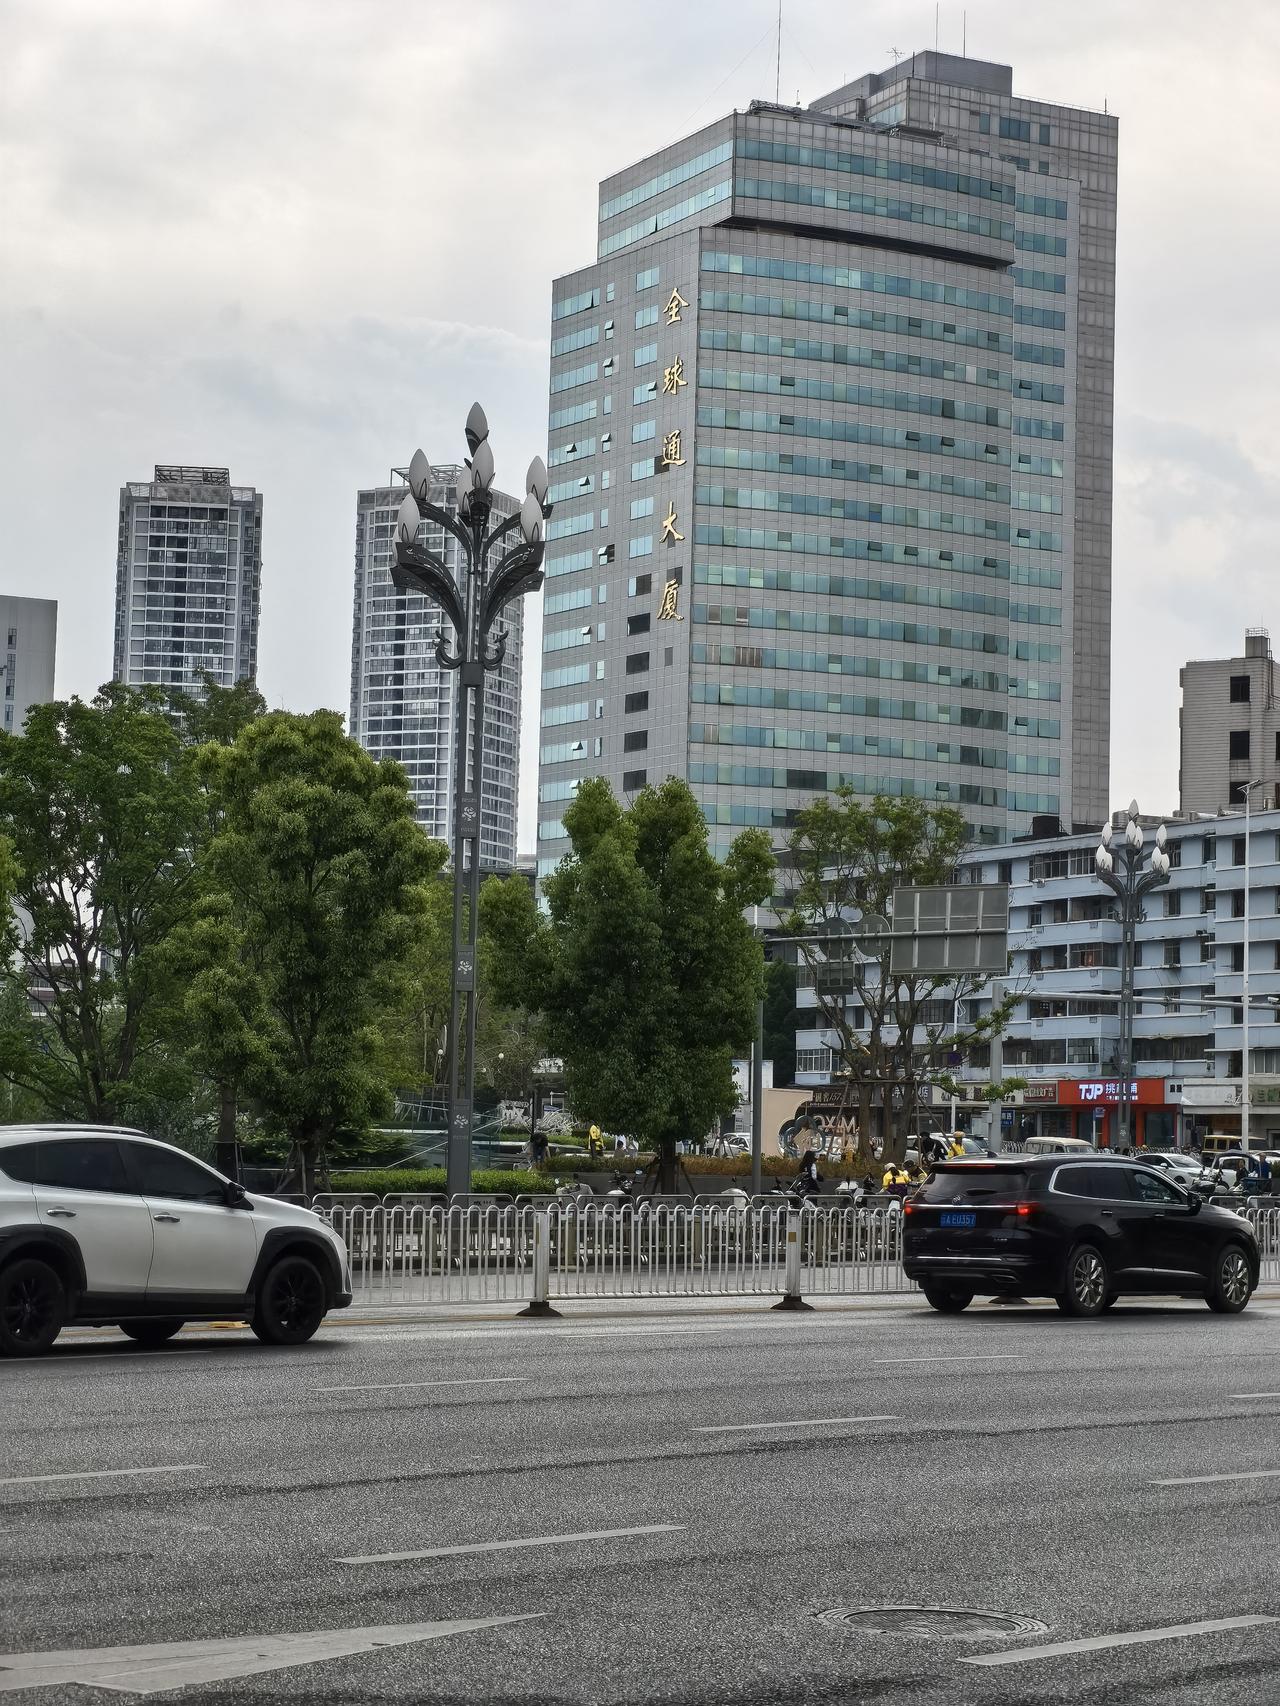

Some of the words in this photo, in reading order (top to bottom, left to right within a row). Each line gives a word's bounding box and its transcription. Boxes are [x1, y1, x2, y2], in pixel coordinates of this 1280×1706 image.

[656, 287, 691, 621] 全球通大厦
[1079, 1083, 1104, 1100] TJP
